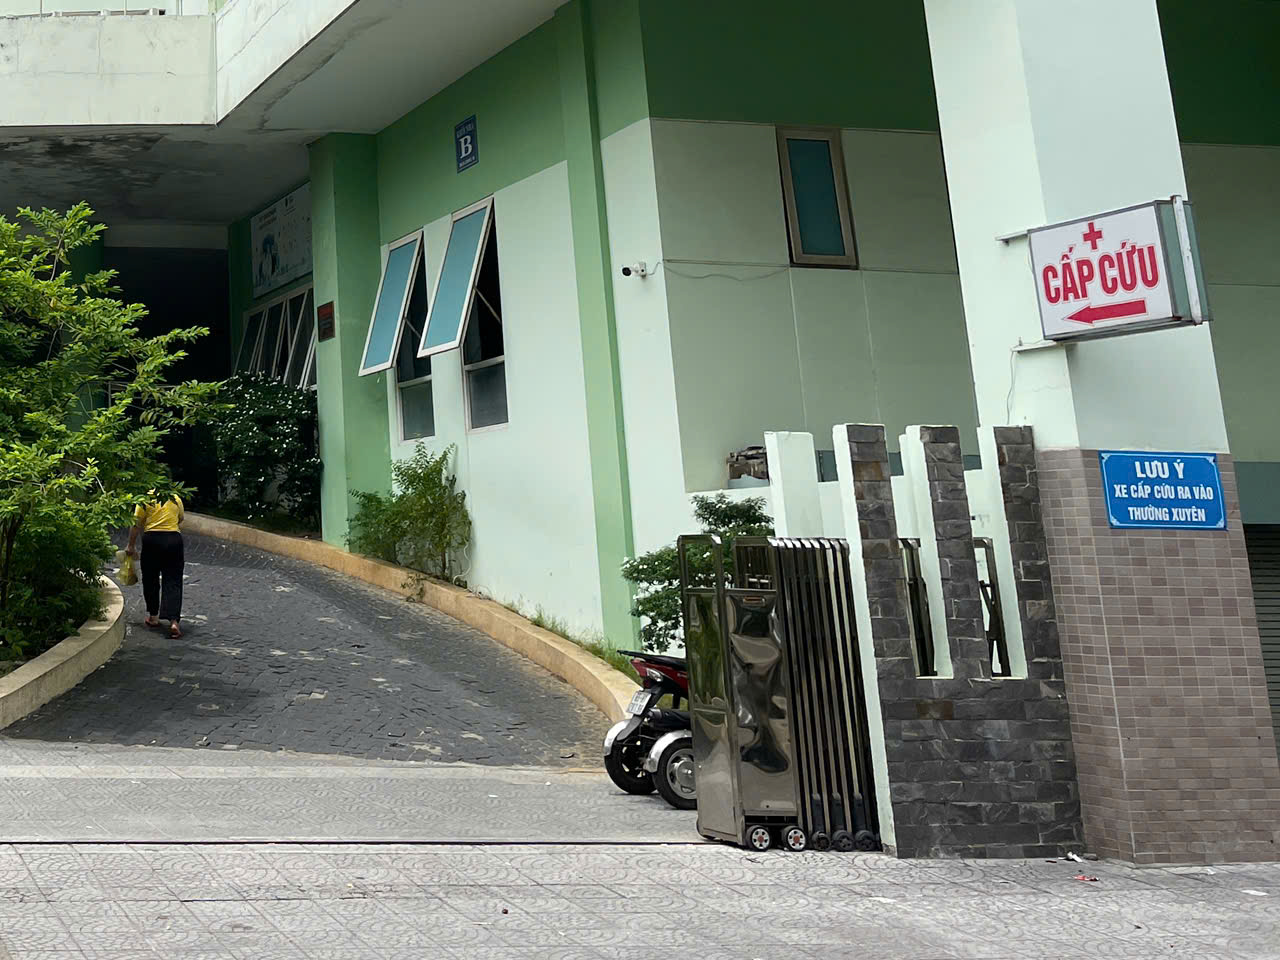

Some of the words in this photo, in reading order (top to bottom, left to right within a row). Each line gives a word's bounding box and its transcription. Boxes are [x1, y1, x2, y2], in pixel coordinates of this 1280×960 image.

[459, 135, 473, 159] B
[1042, 246, 1095, 304] CẤP
[1099, 241, 1159, 295] CỨU
[1134, 460, 1170, 479] LƯU
[1173, 458, 1184, 479] Ý
[1113, 484, 1128, 498] XE
[1130, 480, 1151, 499] CẤP
[1154, 482, 1175, 499] CỨU
[1177, 486, 1192, 500] RA
[1193, 483, 1214, 500] VÀO
[1128, 503, 1170, 521] THƯỜNG
[1172, 505, 1207, 522] XUYÊN
